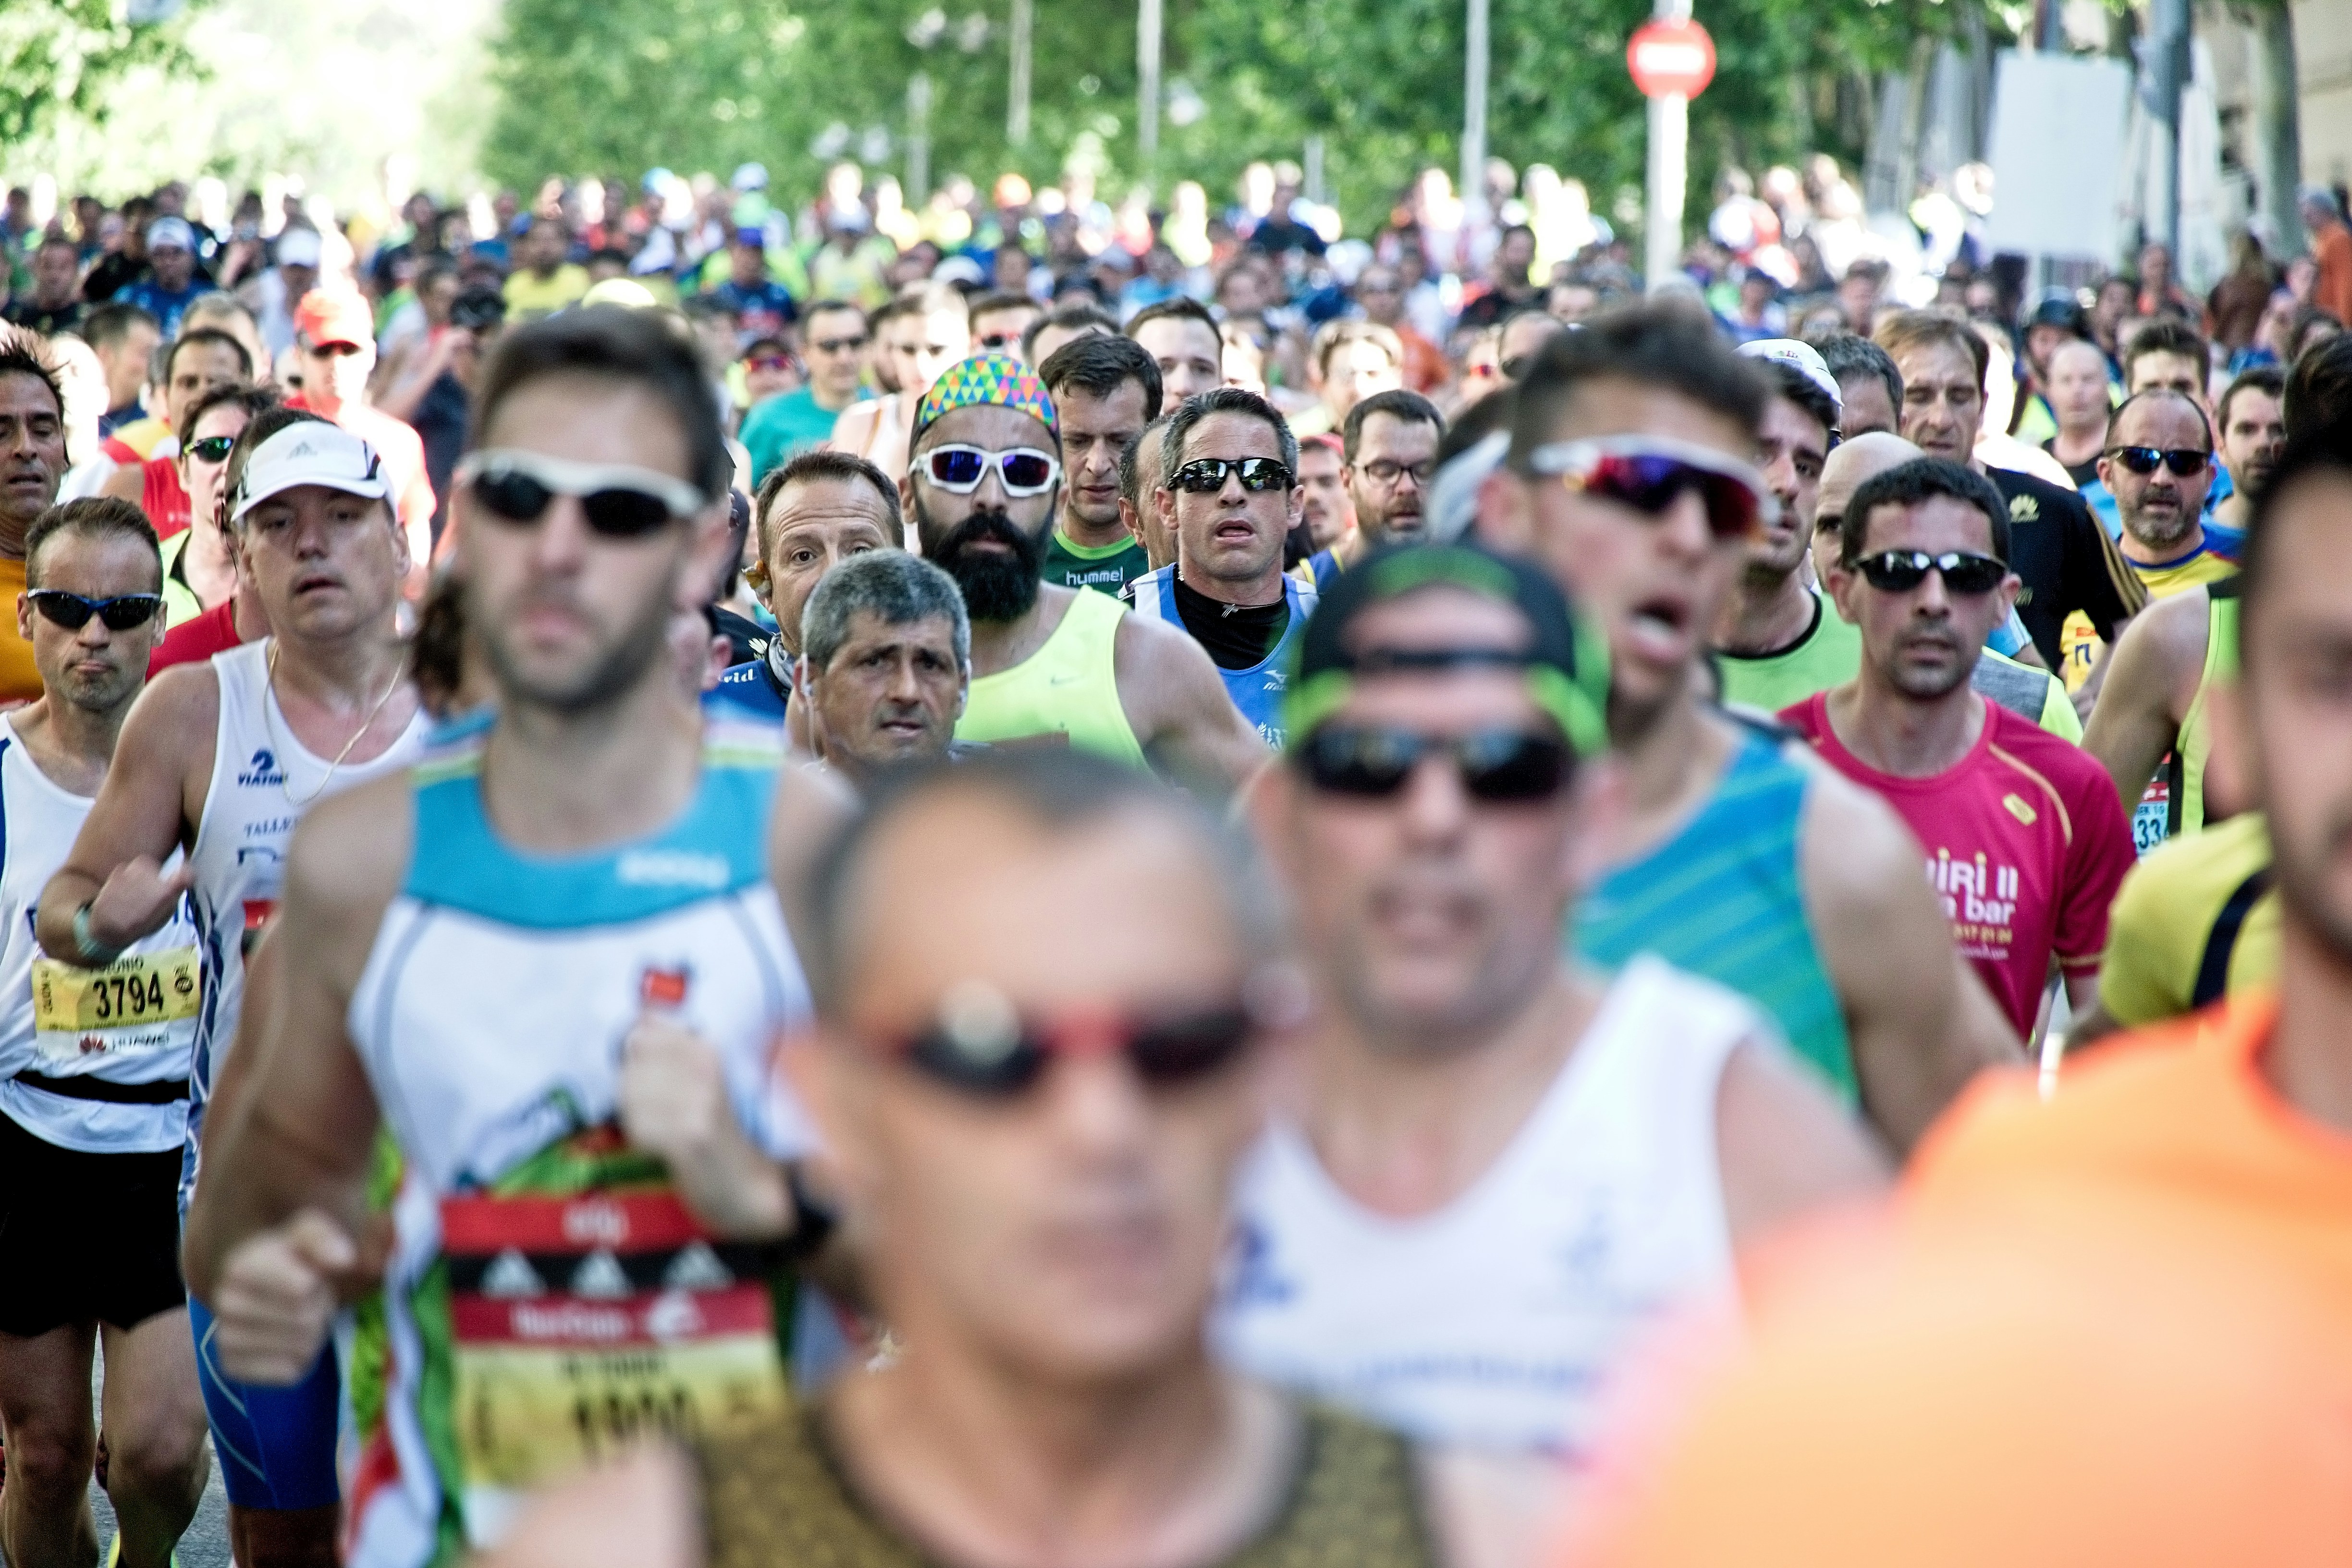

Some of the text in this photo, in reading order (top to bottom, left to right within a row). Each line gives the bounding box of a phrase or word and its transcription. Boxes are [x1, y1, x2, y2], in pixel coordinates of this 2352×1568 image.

[1066, 566, 1123, 586] hummel
[1966, 899, 2015, 925] bar
[93, 971, 164, 1019] 3794
